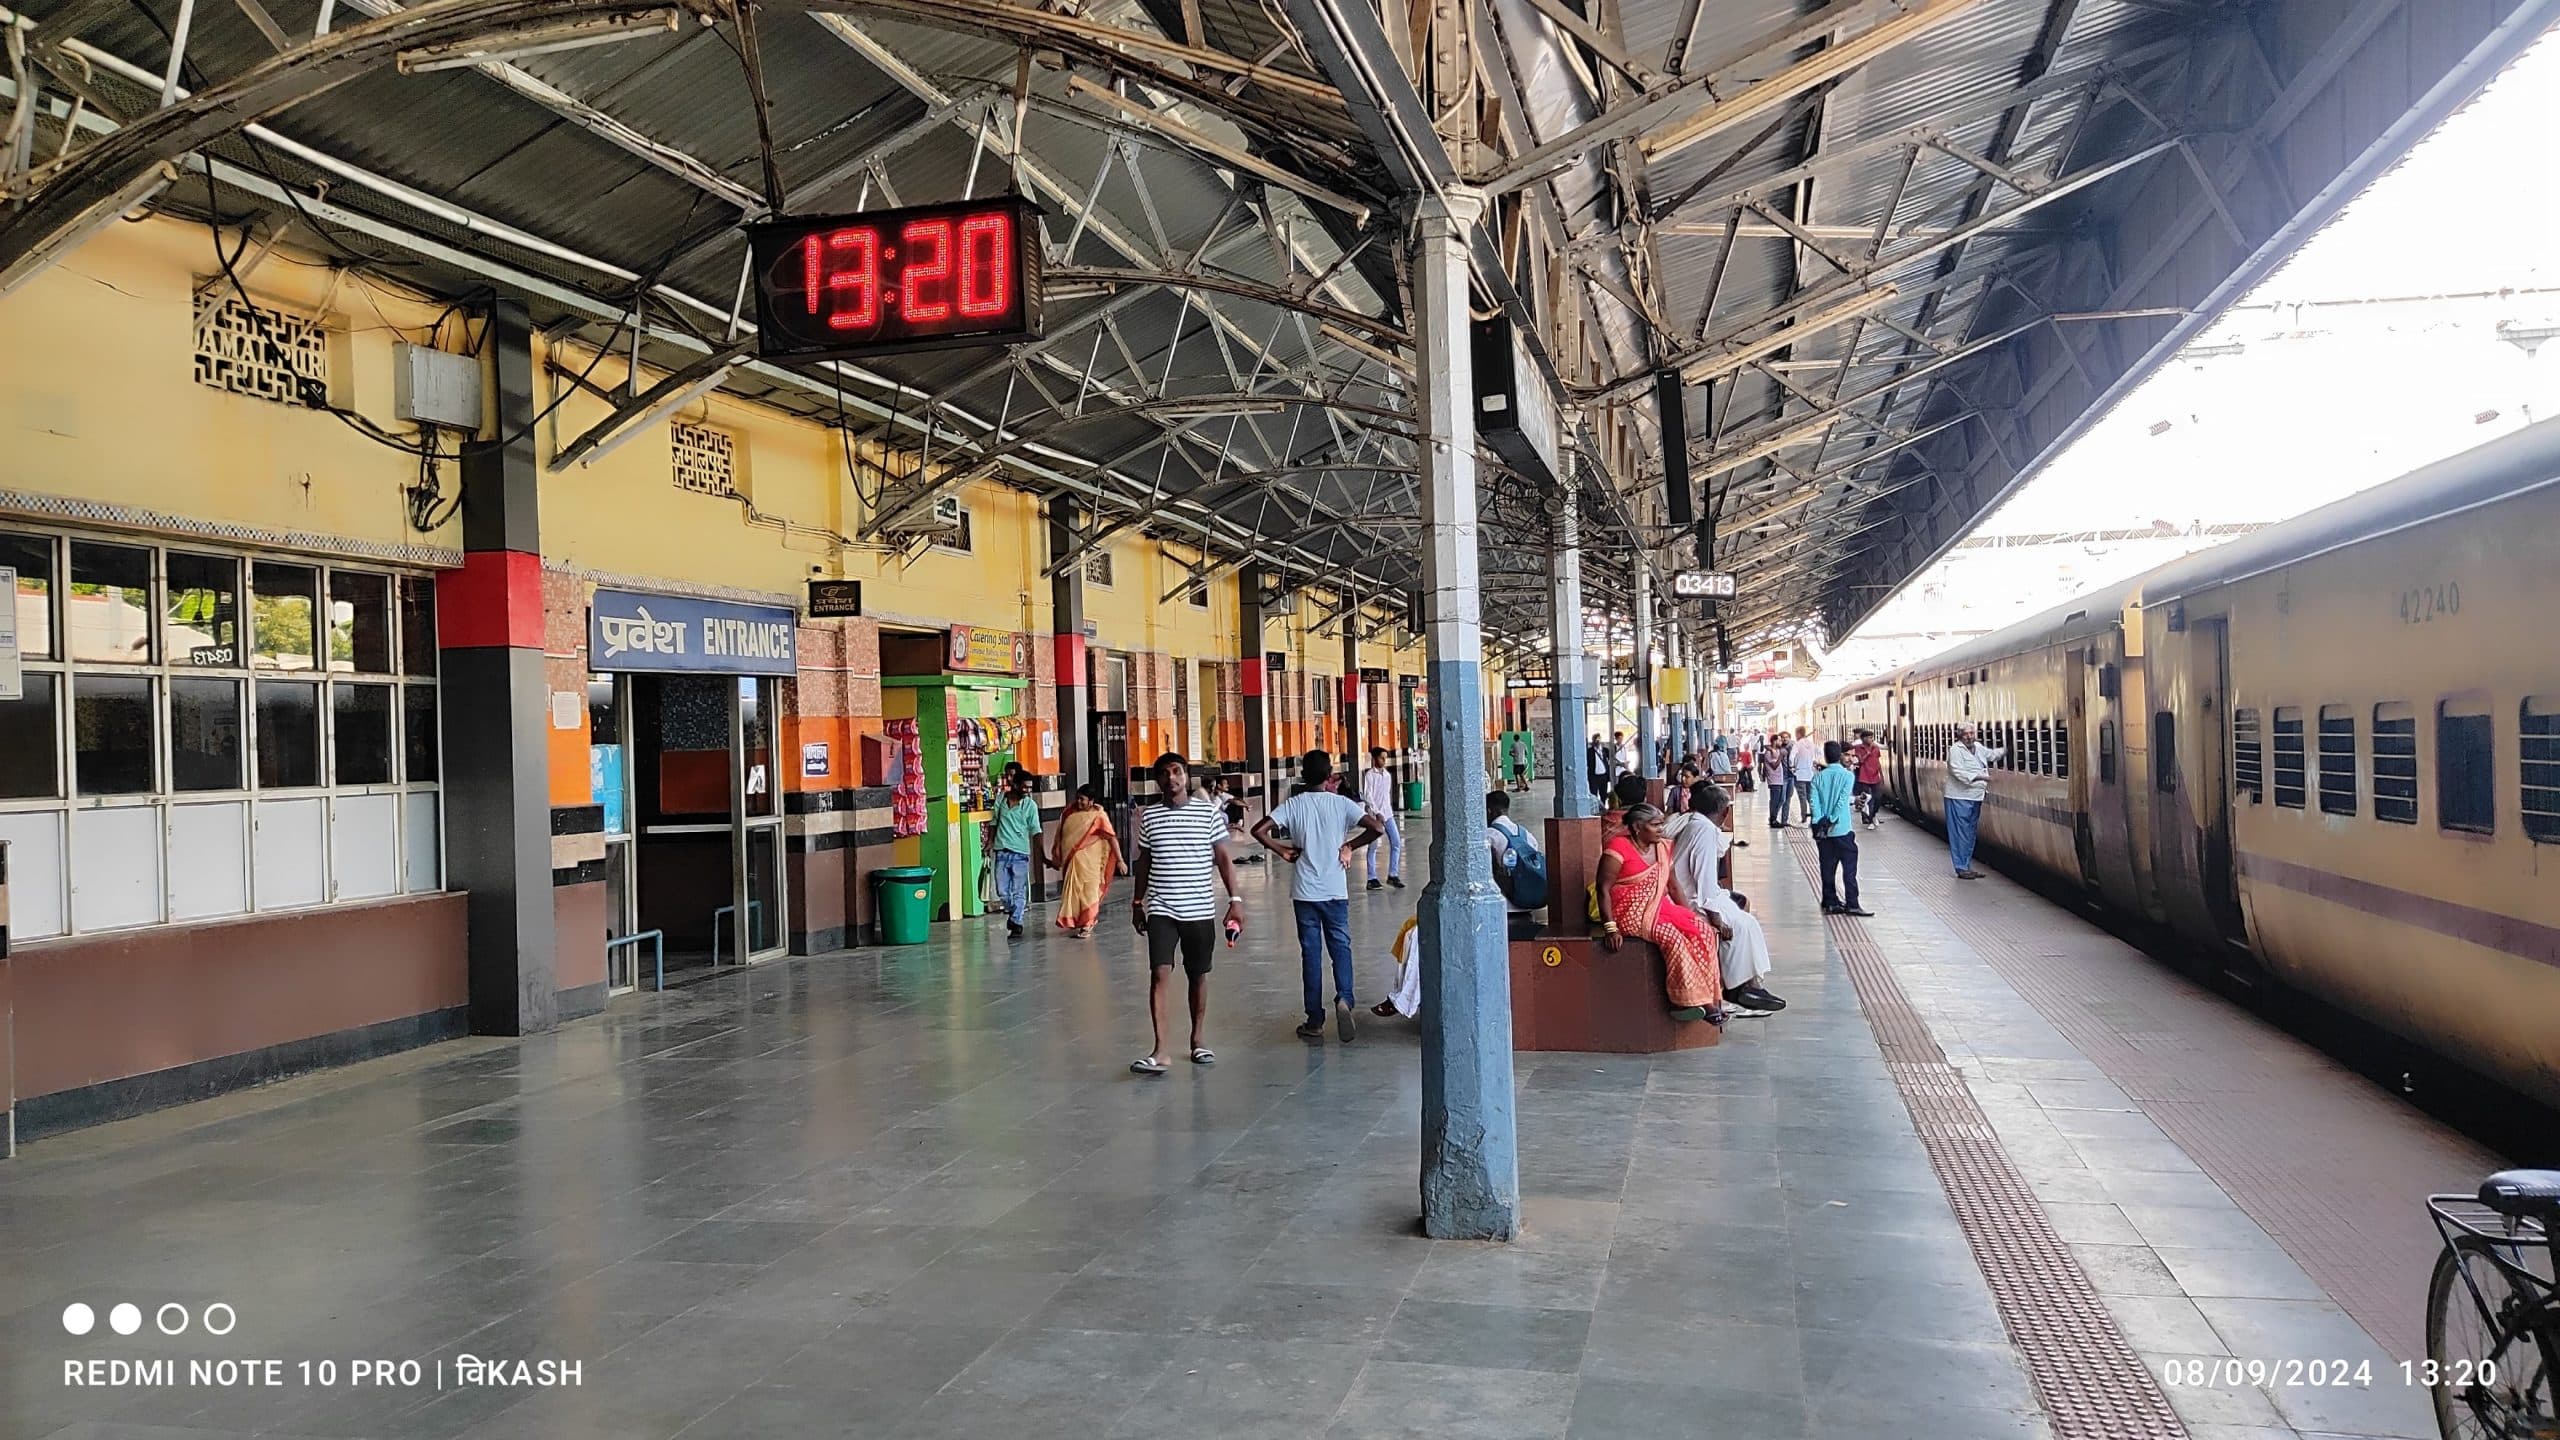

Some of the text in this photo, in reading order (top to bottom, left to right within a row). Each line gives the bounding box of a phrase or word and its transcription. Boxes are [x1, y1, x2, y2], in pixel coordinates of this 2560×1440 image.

[805, 212, 1009, 328] 13:20
[1674, 574, 1734, 594] 03413
[814, 604, 855, 613] ENTRANCE
[2400, 582, 2459, 624] 42240
[600, 606, 790, 659] प्रवेश ENTRANCE
[970, 629, 996, 648] Catering
